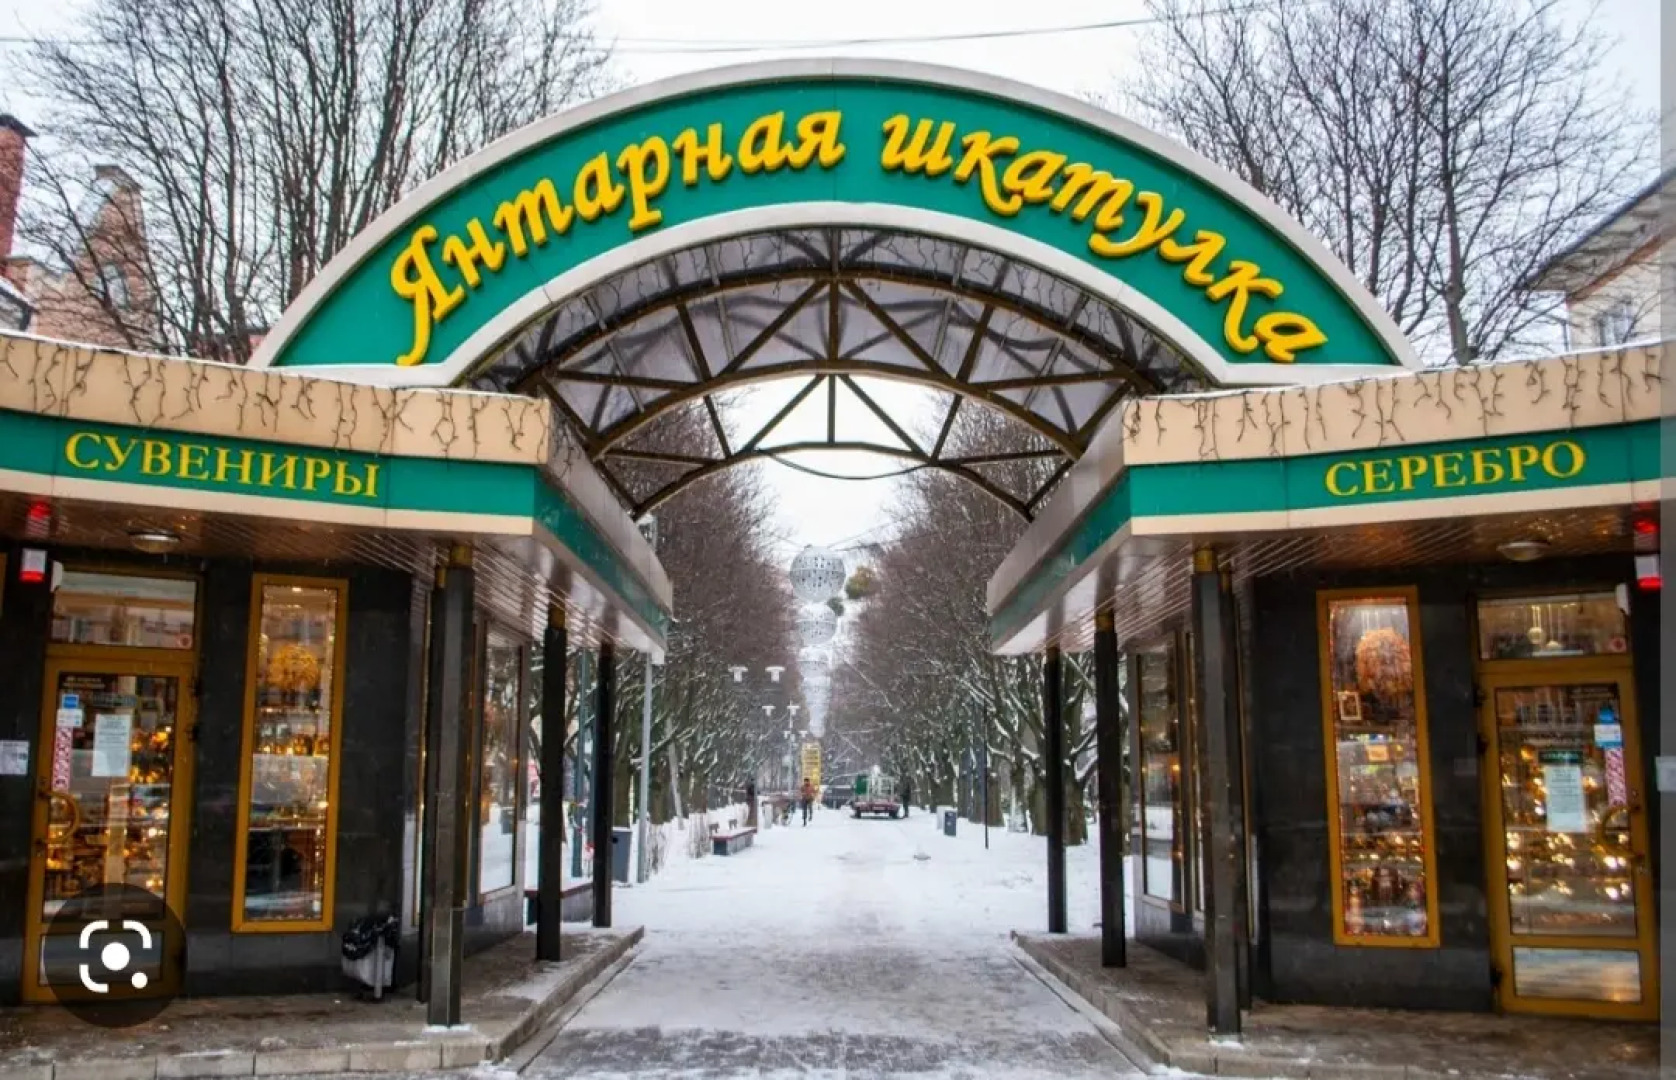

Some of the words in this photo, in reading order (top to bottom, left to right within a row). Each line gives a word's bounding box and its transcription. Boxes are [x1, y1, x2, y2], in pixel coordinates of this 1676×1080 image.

[391, 110, 845, 367] Янтарная
[881, 114, 1328, 362] шкатулка
[65, 433, 380, 497] СУВЕНИРЫ
[1325, 441, 1586, 496] СЕРЕБРО
